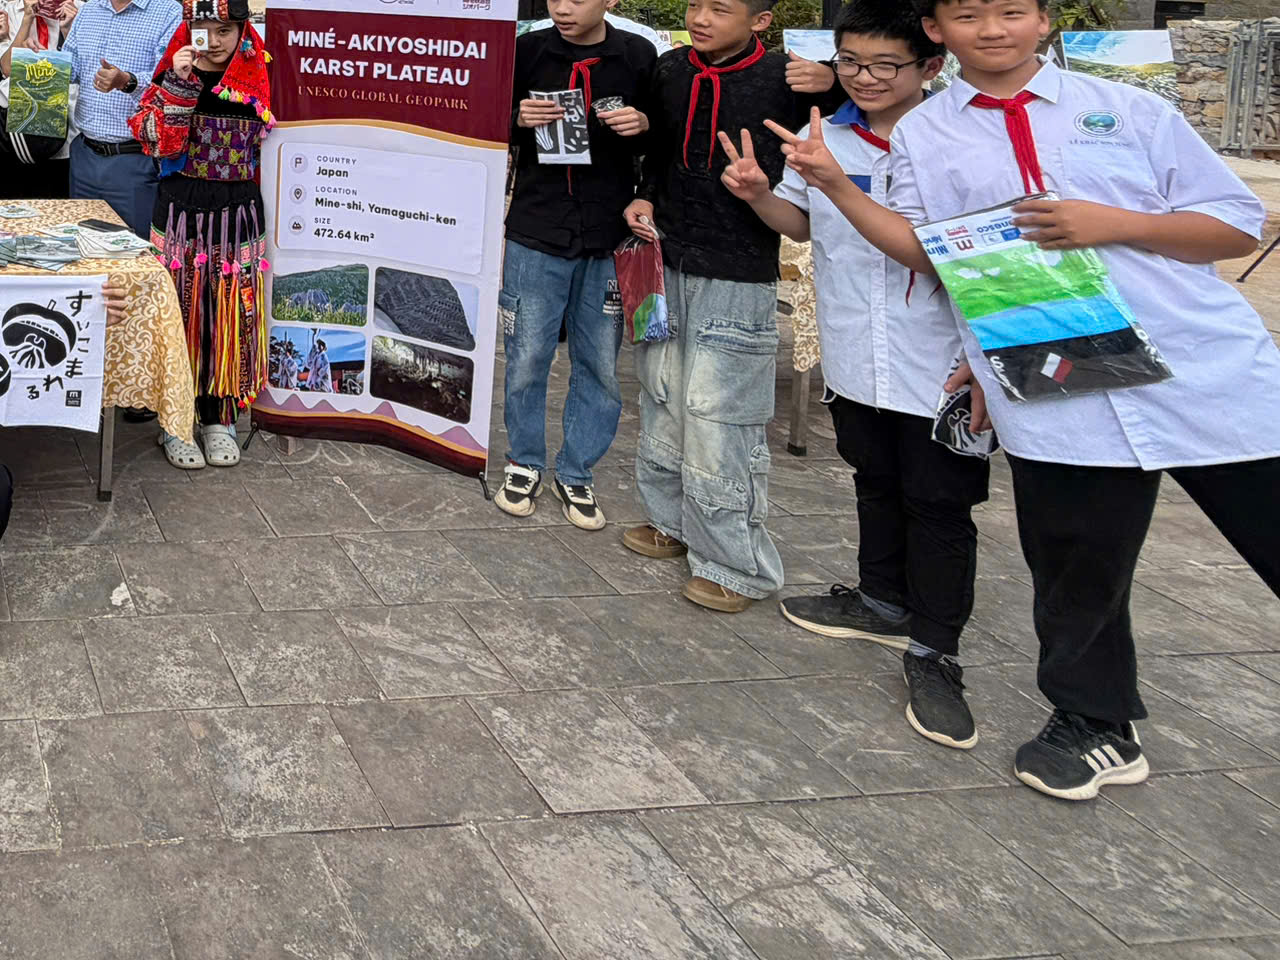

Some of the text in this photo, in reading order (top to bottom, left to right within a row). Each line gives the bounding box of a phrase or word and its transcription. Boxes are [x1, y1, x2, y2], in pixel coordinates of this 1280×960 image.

[299, 57, 470, 86] KARST PLATEAU
[298, 85, 469, 111] UNESCO GLOBAL GEOPARK
[316, 155, 357, 165] COUNTRY
[316, 166, 349, 179] Japan
[315, 186, 358, 196] LOCATION
[315, 197, 457, 226] Mine-shi, Yamaguchi-ken
[314, 217, 332, 225] SIZE
[314, 228, 375, 243] 472.64 km²
